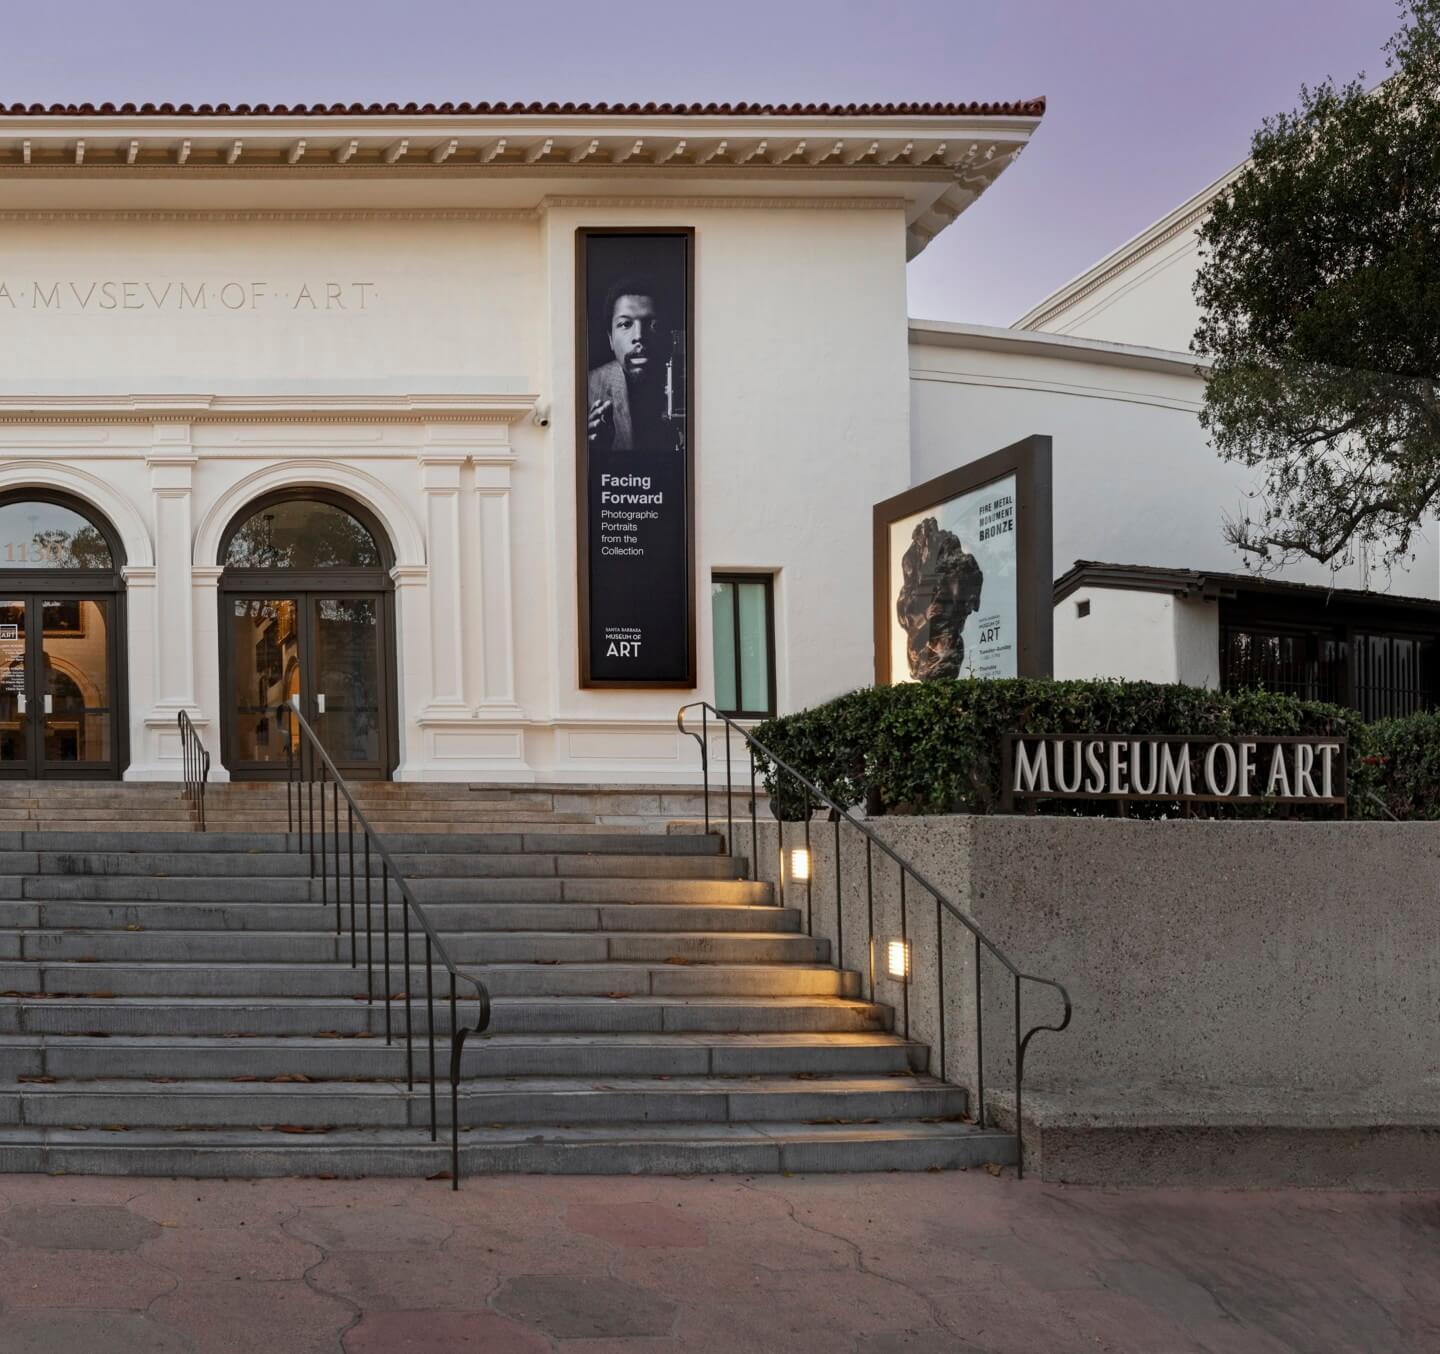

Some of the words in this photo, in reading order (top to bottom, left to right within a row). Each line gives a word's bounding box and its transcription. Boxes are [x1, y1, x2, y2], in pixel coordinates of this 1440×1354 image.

[601, 473, 652, 490] Facing
[601, 491, 663, 505] Forward
[979, 502, 992, 516] FIRE
[993, 495, 1013, 510] METAL
[601, 509, 659, 521] Photographic
[979, 506, 1013, 527] MONUMENT
[601, 521, 638, 532] Portraits
[979, 519, 1014, 542] BRONZE
[601, 534, 622, 544] from
[623, 534, 638, 544] the
[601, 546, 644, 556] Collection
[979, 626, 1001, 644] ART
[606, 641, 642, 657] ART
[1012, 738, 1196, 796] MUSEUM
[1204, 742, 1257, 797] OF
[1265, 743, 1340, 798] ART
